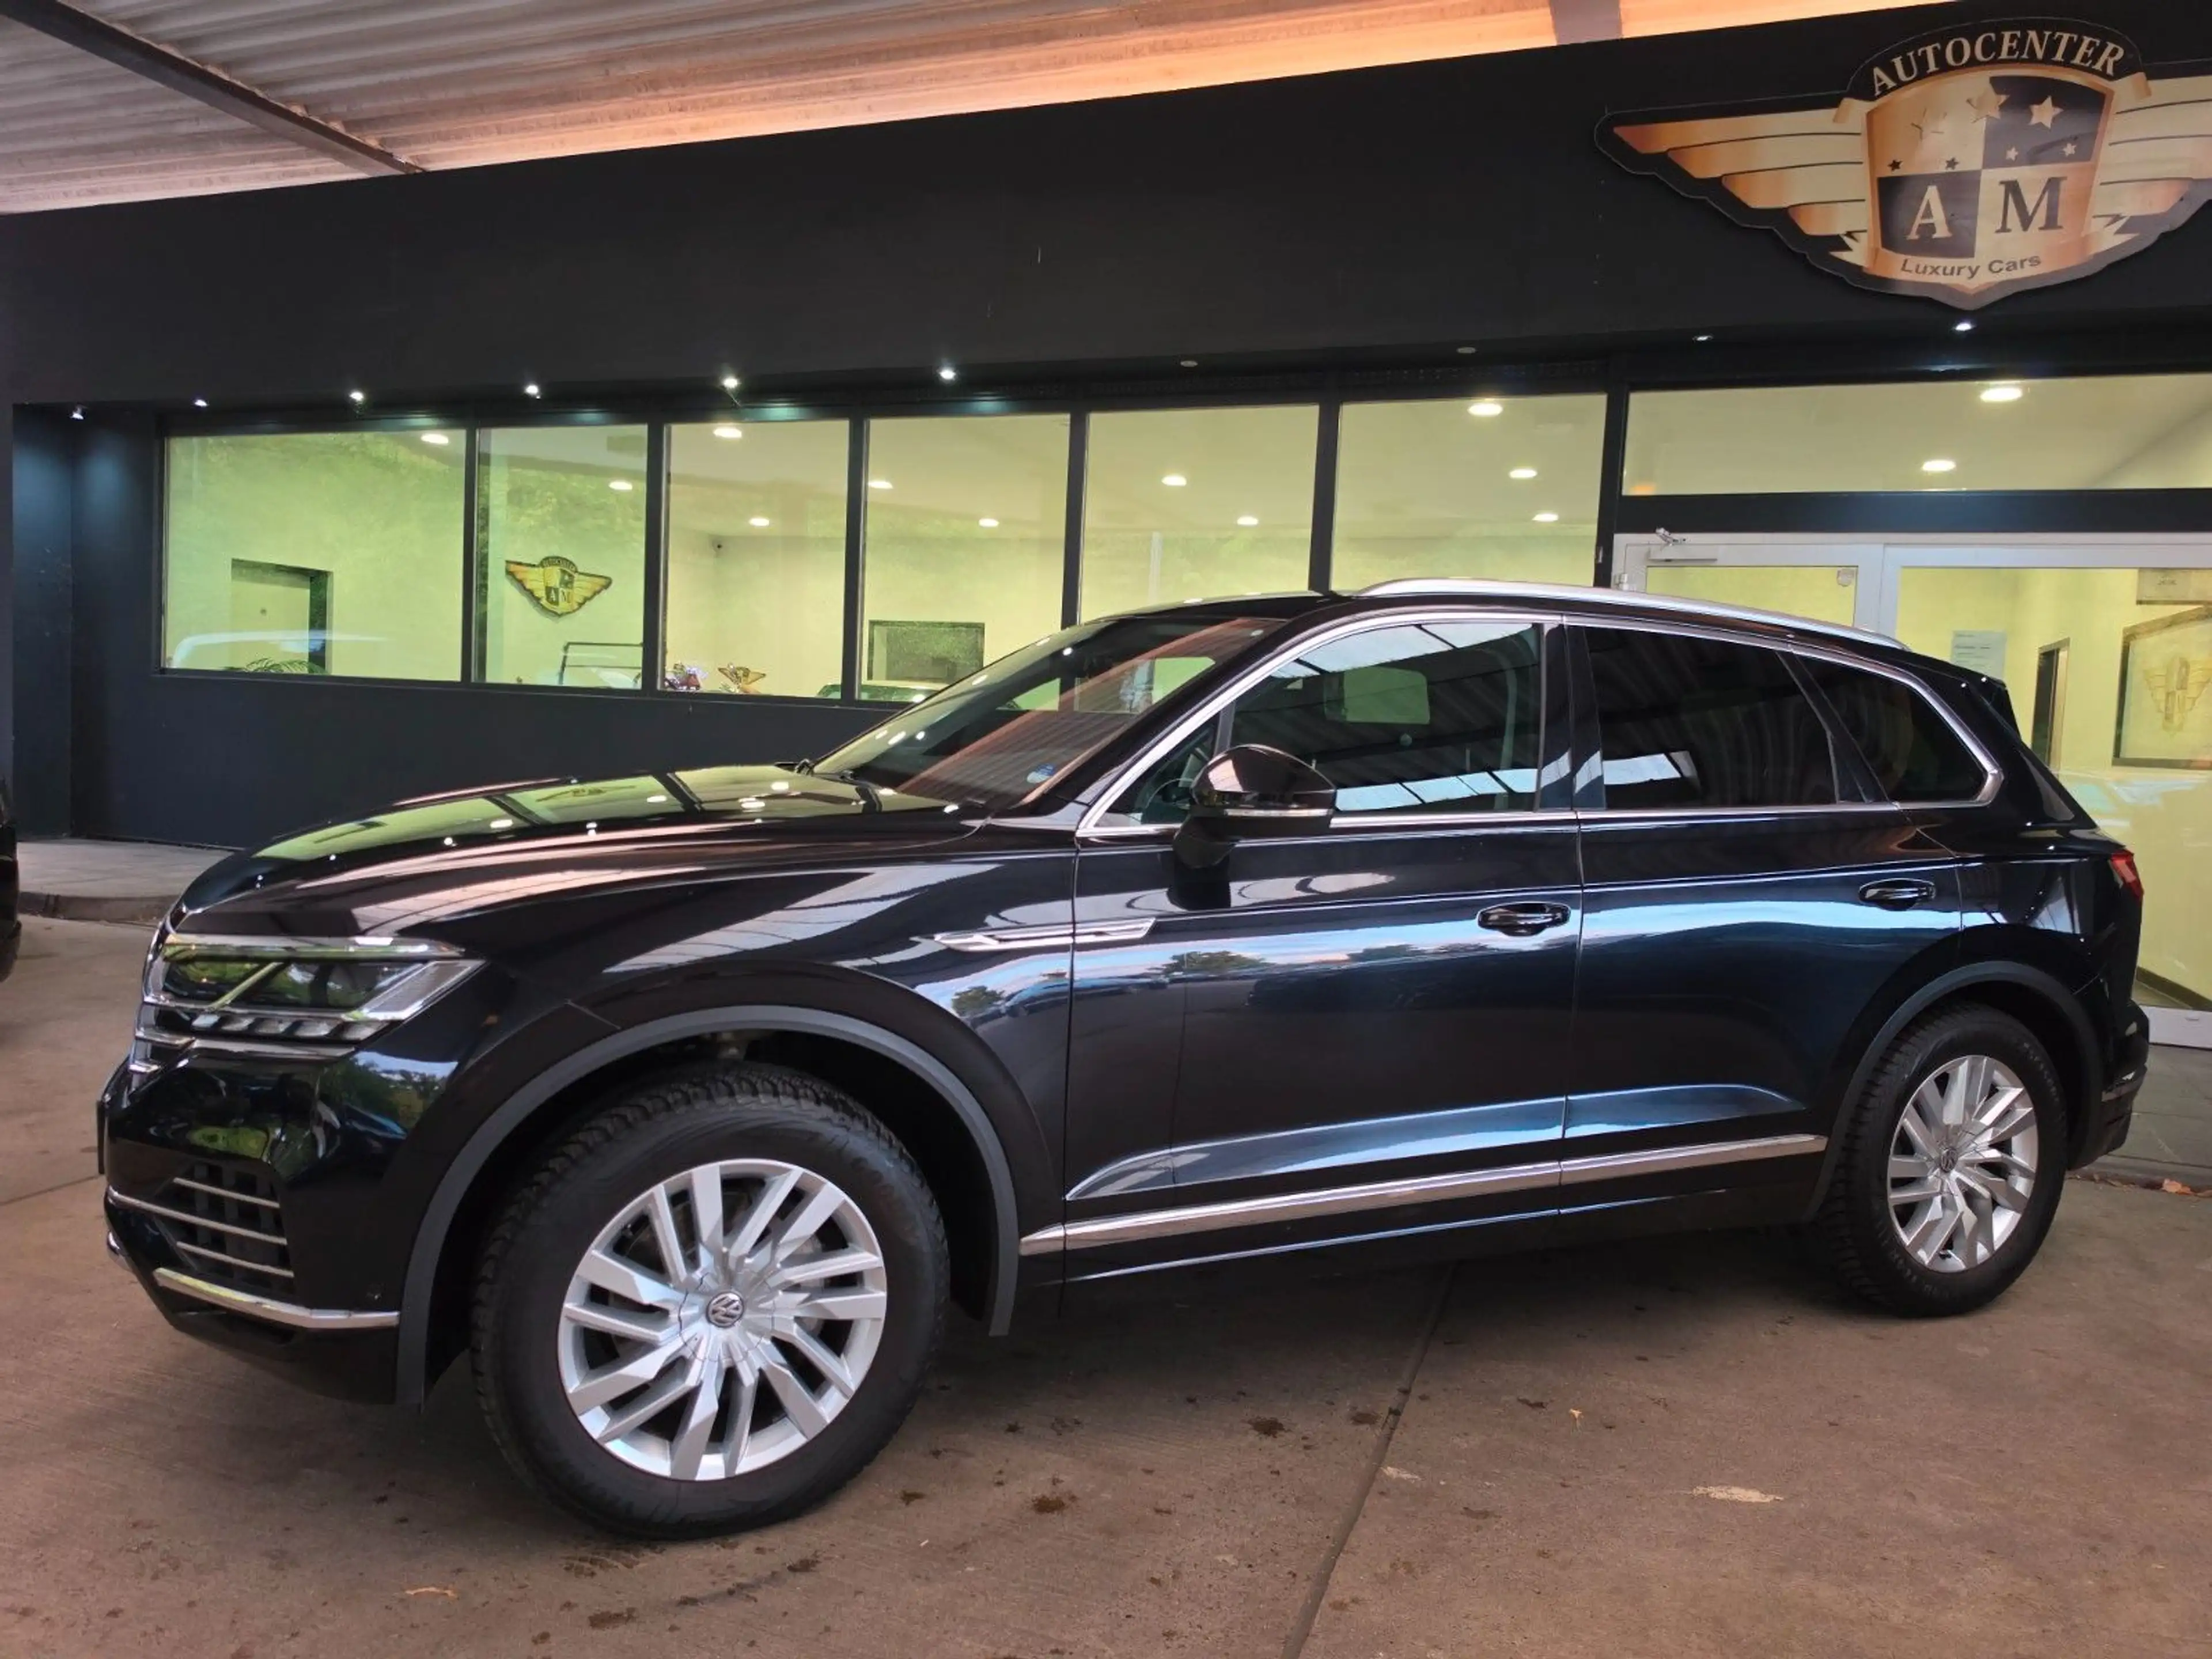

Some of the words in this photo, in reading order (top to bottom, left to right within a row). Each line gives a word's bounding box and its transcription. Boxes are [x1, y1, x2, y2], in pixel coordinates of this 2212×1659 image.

[1873, 30, 2125, 96] AUTOCENTER
[1906, 185, 1953, 240] A
[1995, 176, 2067, 233] M
[1900, 259, 1980, 279] Luxury
[1988, 256, 2041, 274] Cars
